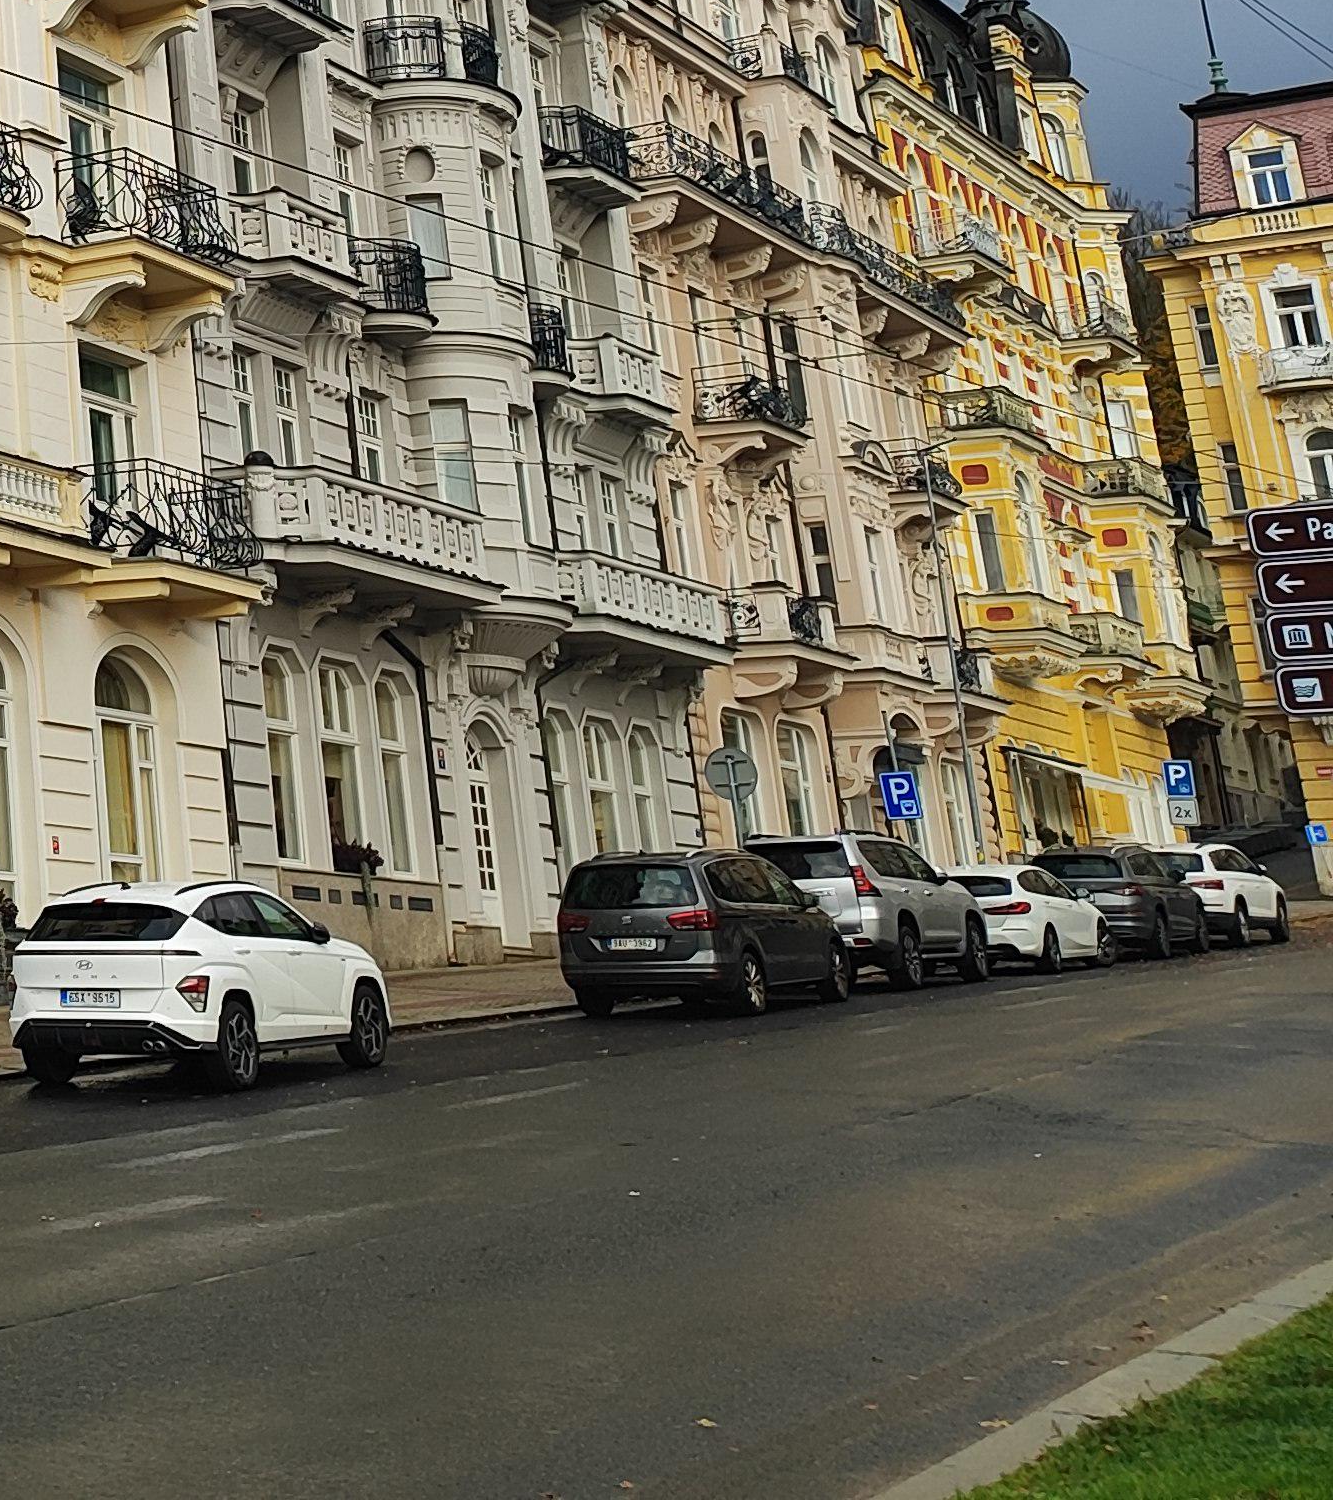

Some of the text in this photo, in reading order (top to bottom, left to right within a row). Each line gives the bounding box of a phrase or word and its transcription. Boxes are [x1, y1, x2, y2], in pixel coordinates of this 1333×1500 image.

[1168, 765, 1186, 786] P
[889, 778, 910, 805] P
[1174, 806, 1192, 818] 2x
